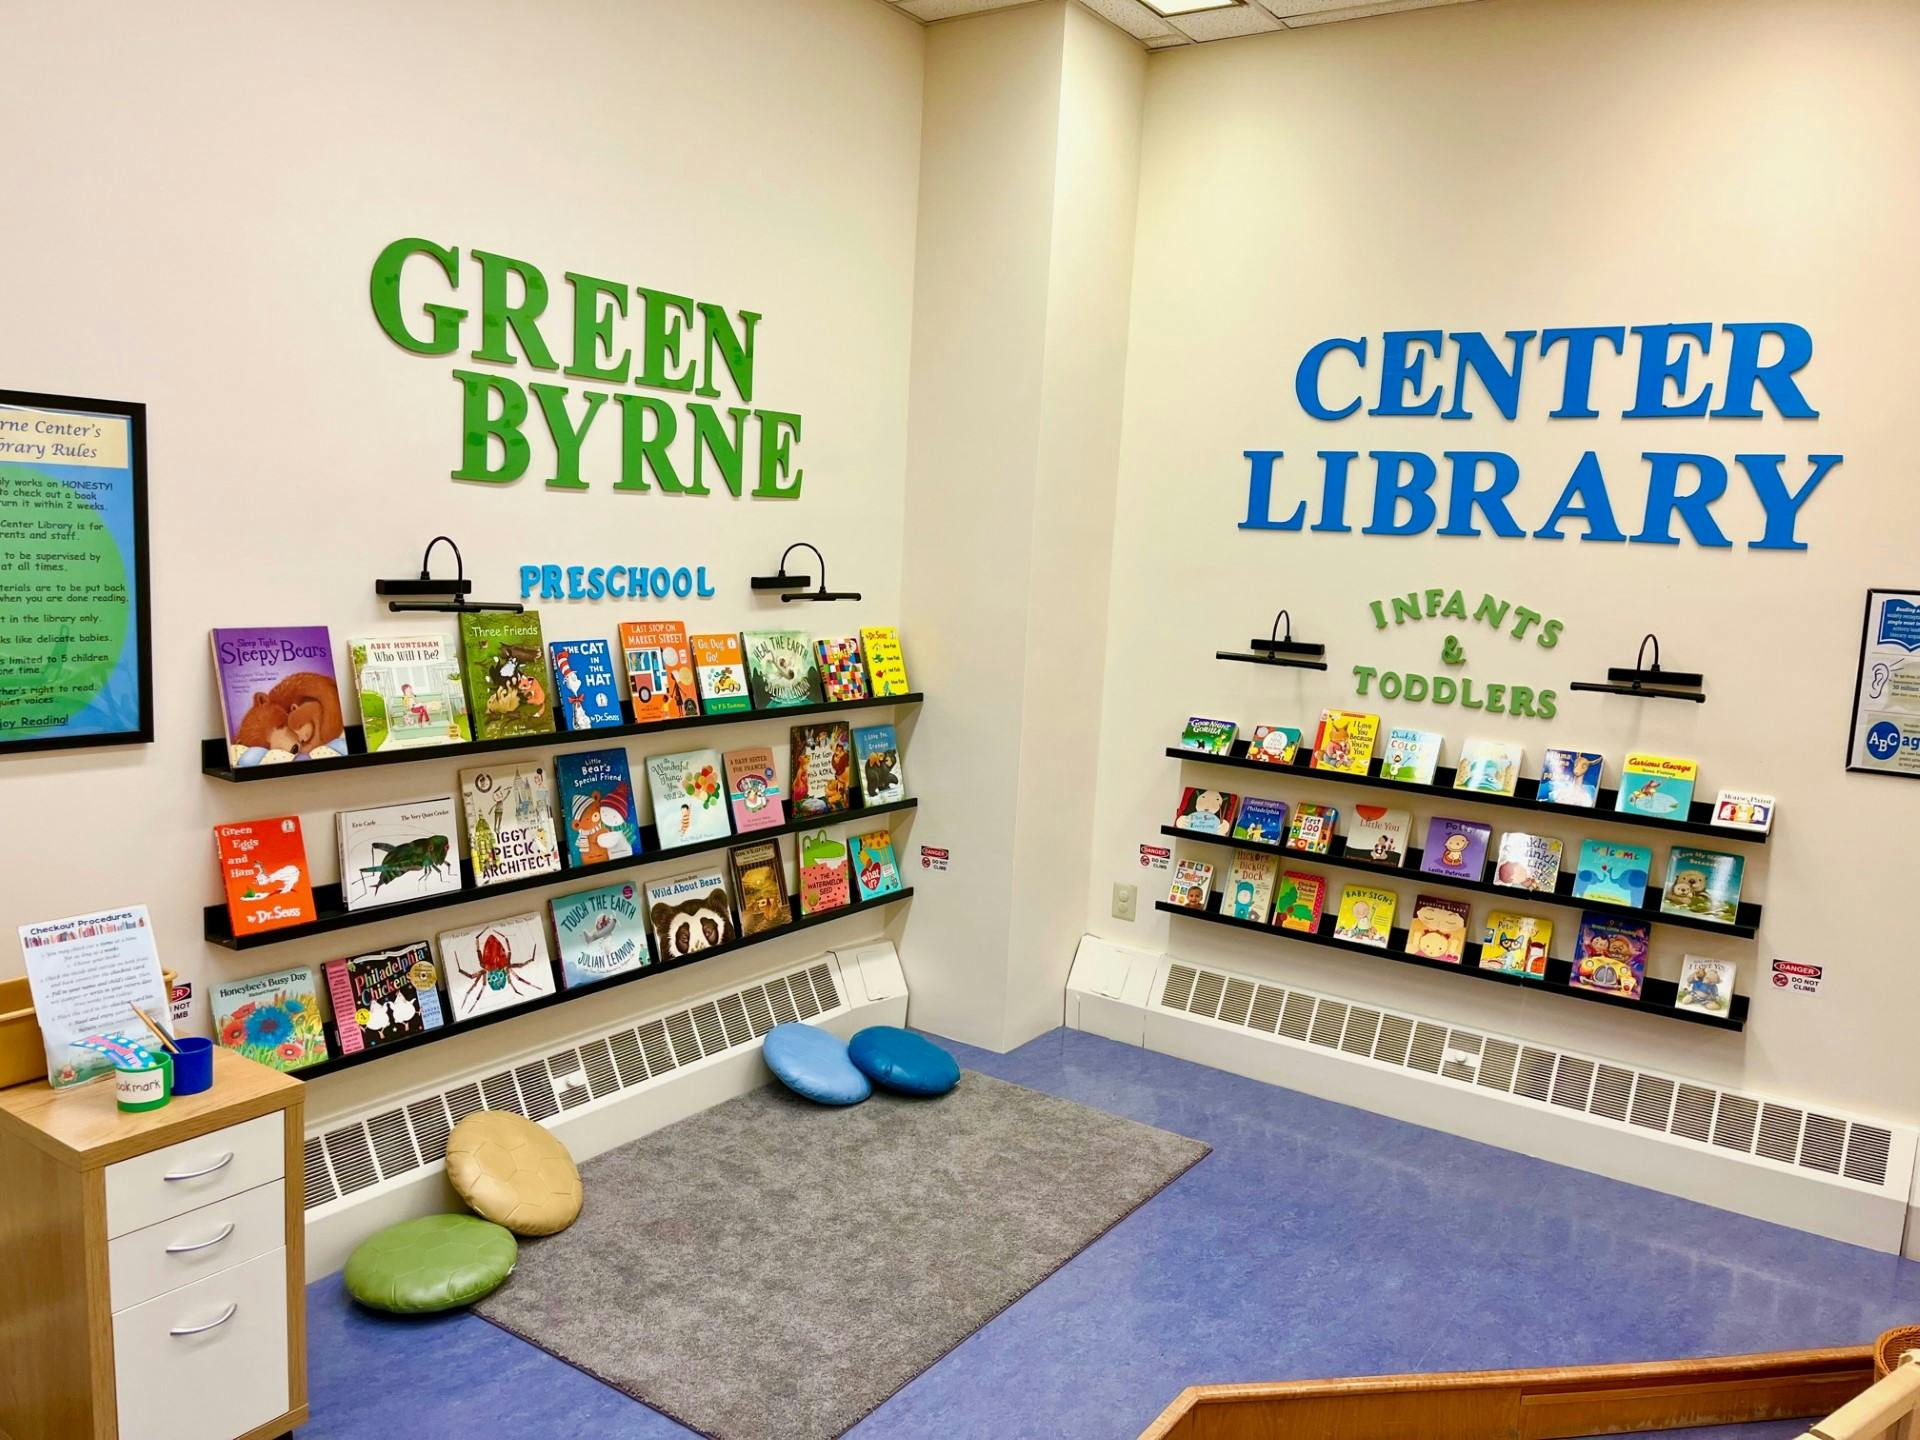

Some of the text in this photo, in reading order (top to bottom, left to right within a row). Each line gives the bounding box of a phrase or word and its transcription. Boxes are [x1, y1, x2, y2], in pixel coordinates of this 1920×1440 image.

[370, 237, 762, 402] GREEN
[1295, 321, 1820, 421] CENTER
[35, 420, 102, 438] Center's
[451, 368, 803, 499] BYRNE
[52, 443, 98, 458] Rules
[14, 478, 43, 488] works
[13, 488, 97, 500] check out book
[22, 499, 73, 509] it within 2
[1237, 450, 1844, 551] LIBRARY
[38, 520, 73, 534] Library
[89, 522, 104, 530] for
[29, 531, 47, 540] and
[5, 551, 101, 563] to be supervised by
[17, 562, 30, 571] all
[520, 564, 715, 600] PRESCHOOL
[69, 584, 81, 592] be
[85, 584, 101, 594] put
[104, 584, 126, 592] back
[25, 595, 43, 604] you
[67, 594, 89, 602] done
[9, 614, 76, 625] in the library
[1368, 588, 1565, 650] INFANTS
[471, 625, 538, 638] Three Friends
[15, 635, 33, 644] like
[37, 635, 75, 643] delicate
[237, 637, 278, 647] Sleep Tight
[370, 641, 439, 650] ABBY HUNTSMAN
[628, 635, 656, 645] MARKET
[221, 640, 327, 666] Sleepy Bears
[563, 642, 604, 656] THE CAT
[769, 636, 784, 650] THE
[787, 637, 808, 660] EARTH
[1441, 635, 1466, 665] &
[47, 656, 57, 664] to
[71, 655, 110, 663] children
[374, 648, 439, 663] Who Will I Be?
[589, 665, 604, 673] THE
[585, 673, 611, 687] HAT
[30, 686, 54, 696] right
[1352, 665, 1558, 720] TODDLERS
[21, 715, 69, 726] Reading!
[1354, 748, 1365, 756] You
[585, 758, 602, 766] Little
[1629, 758, 1660, 768] Curious
[1662, 762, 1692, 773] George
[581, 765, 612, 775] Bear's
[651, 761, 688, 776] Wonderful
[574, 773, 622, 788] Special Friend
[1247, 806, 1280, 815] Philadelphia
[1305, 816, 1320, 825] first
[1359, 819, 1400, 832] Little You
[222, 827, 252, 837] Green
[1302, 823, 1319, 833] 100
[497, 829, 528, 844] IGGY
[232, 839, 259, 851] Eggs
[924, 849, 945, 857] DANGER
[228, 855, 248, 865] and
[482, 854, 552, 878] ARCHITECT
[230, 869, 254, 879] Ham
[1242, 871, 1263, 880] Dock
[651, 887, 673, 899] Wild
[674, 882, 698, 896] About
[700, 876, 722, 889] Bears
[808, 878, 844, 890] WATERMELON
[820, 887, 833, 896] SEED
[1346, 889, 1393, 905] BABY SIGNS
[273, 906, 300, 919] Seuss
[561, 904, 589, 933] TOUCH
[590, 894, 608, 912] THE
[610, 895, 637, 920] EARTH
[30, 912, 133, 936] Checkout Procedures
[577, 939, 635, 969] JULIAN LENNON
[355, 949, 425, 996] Philadelphia
[1779, 963, 1815, 975] DANGER
[219, 981, 267, 999] Honeybee's
[268, 976, 289, 988] Busy
[290, 972, 307, 984] Day
[1793, 984, 1815, 993] CLIMB
[1805, 979, 1819, 987] NOT
[174, 1002, 190, 1011] NOT
